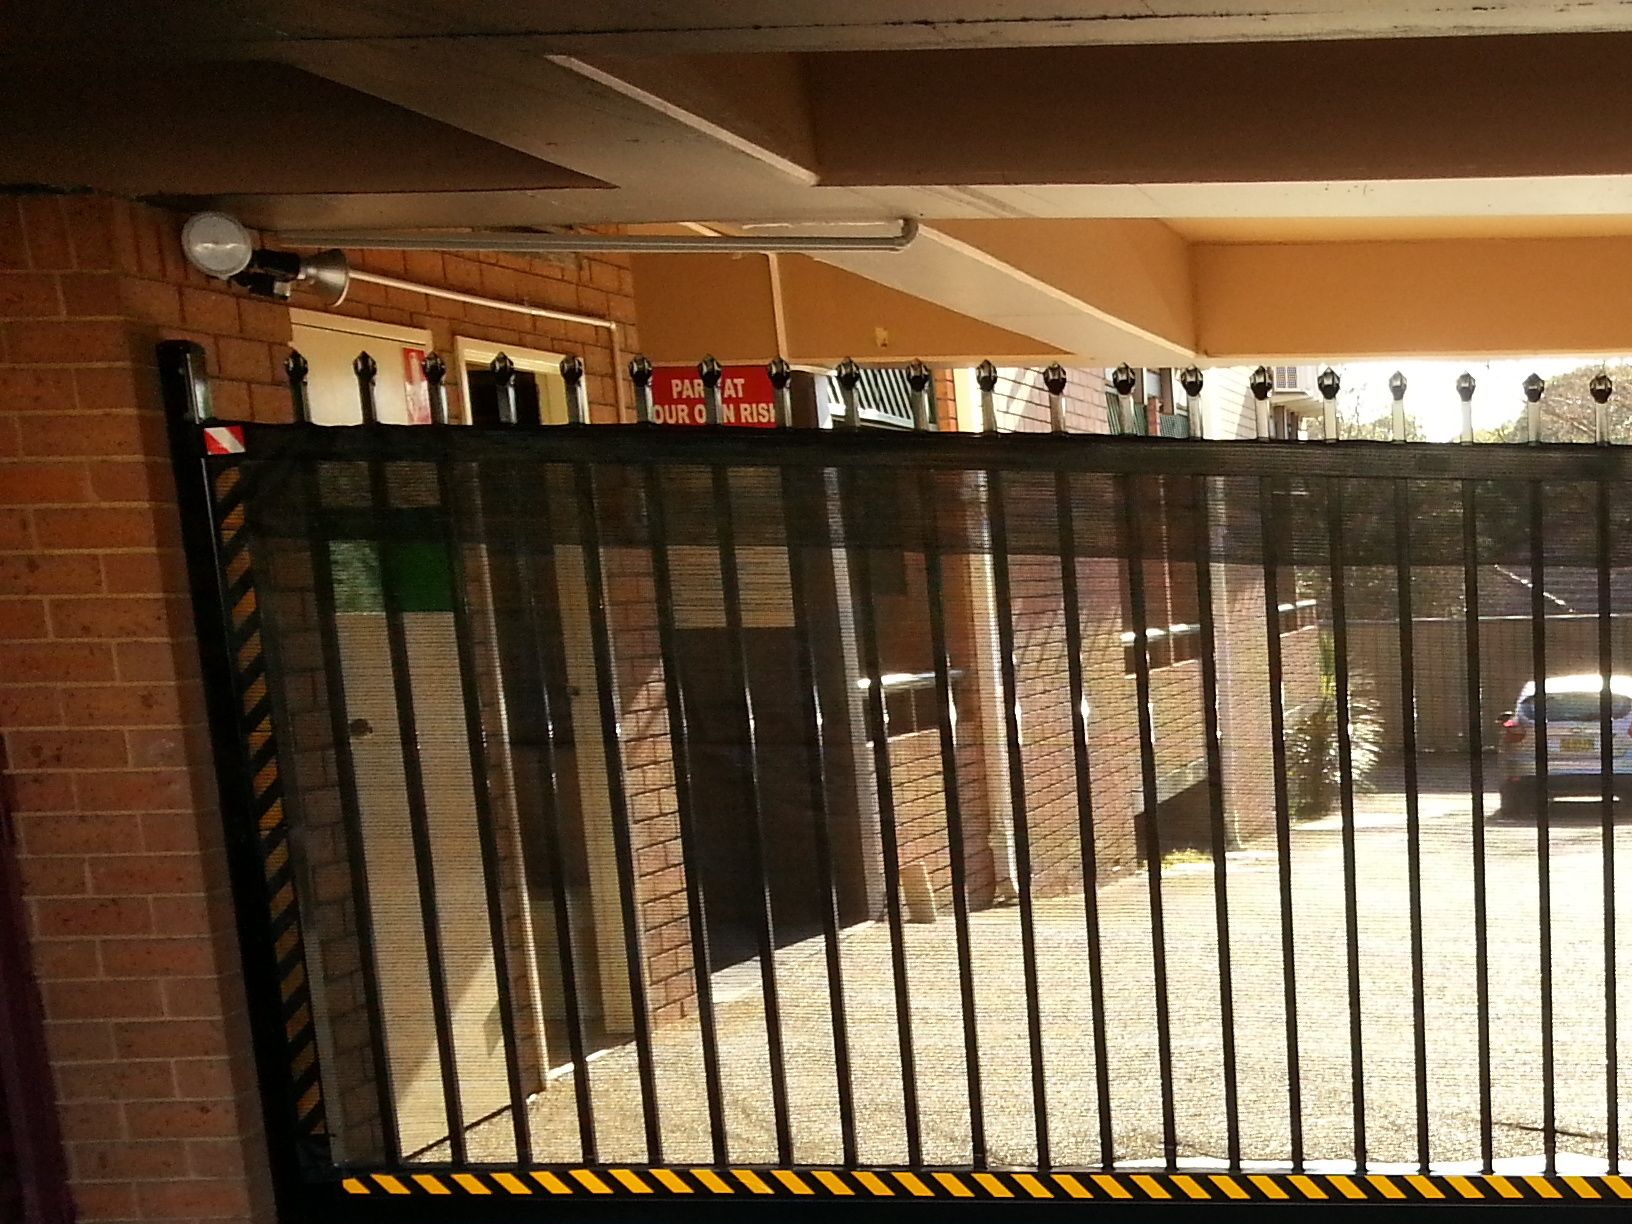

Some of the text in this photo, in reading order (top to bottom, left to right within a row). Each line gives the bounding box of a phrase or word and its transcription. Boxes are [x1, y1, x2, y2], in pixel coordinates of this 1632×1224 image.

[671, 378, 745, 399] PAR AT
[652, 404, 690, 424] OUR
[694, 403, 735, 423] ON
